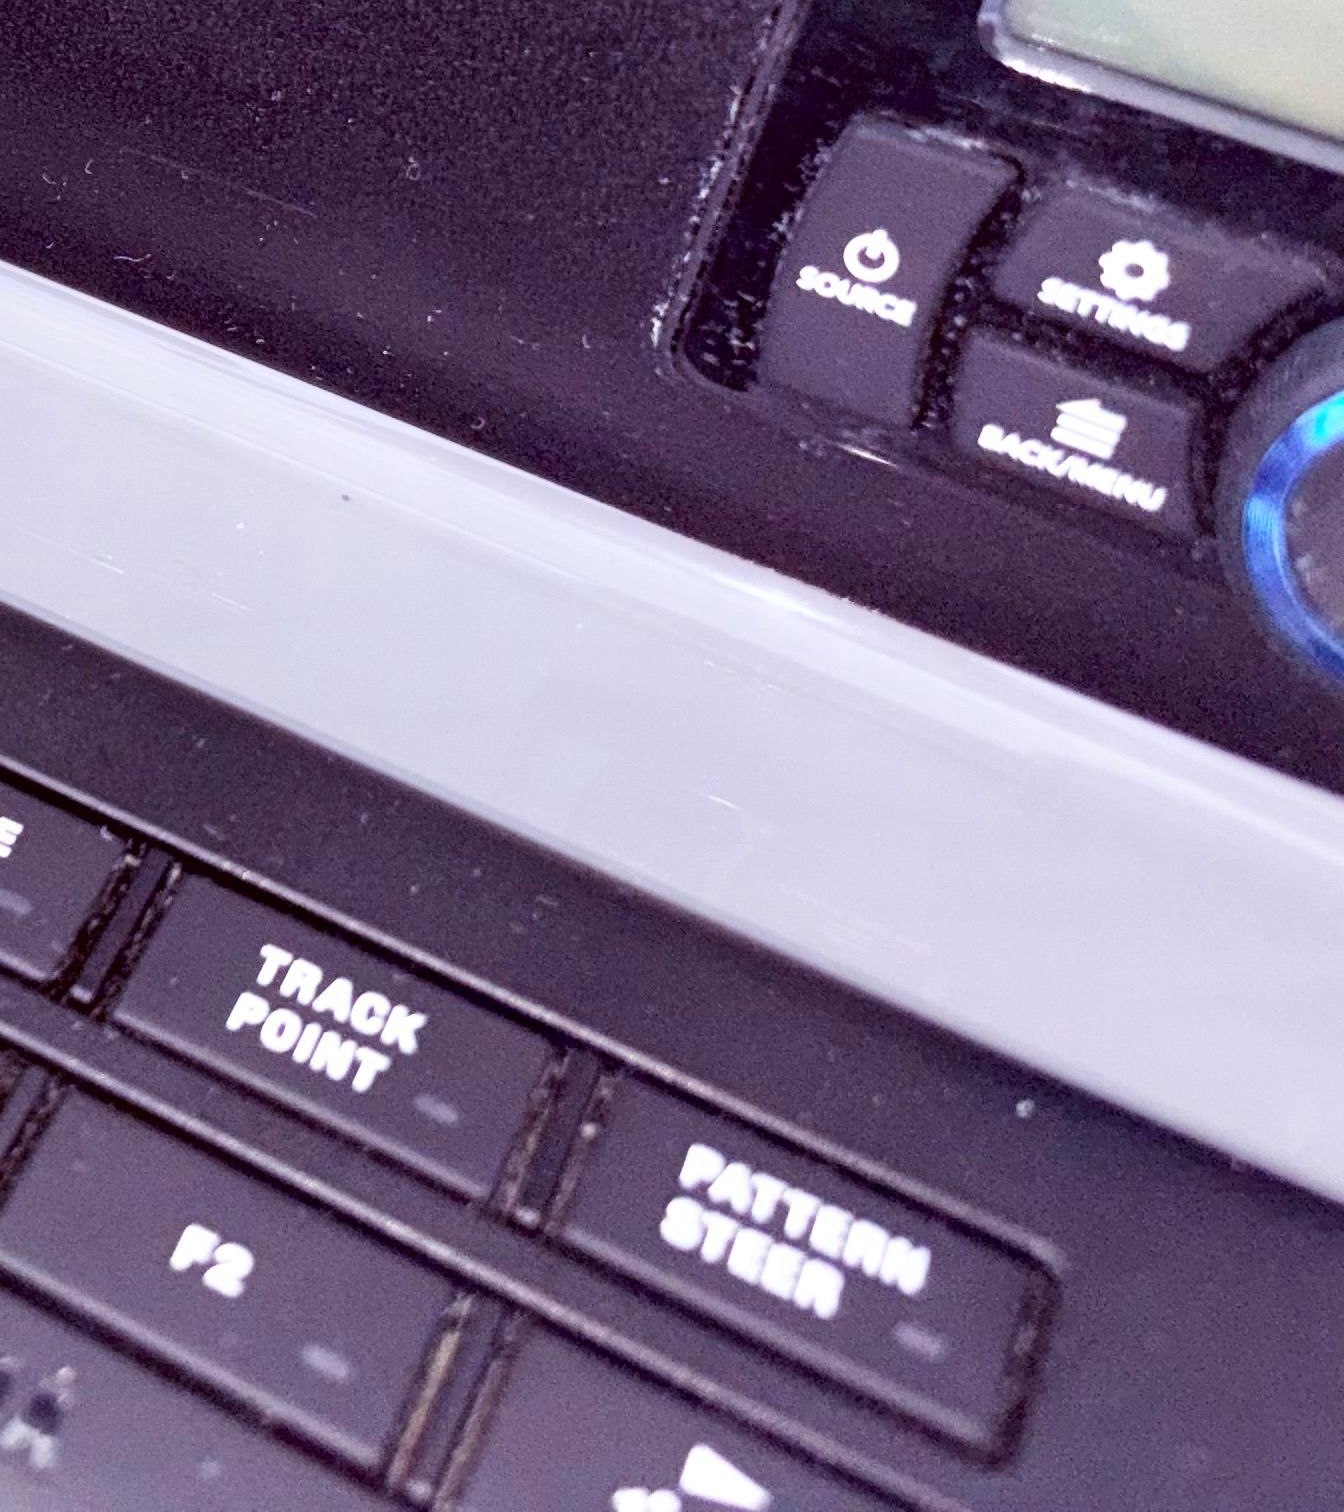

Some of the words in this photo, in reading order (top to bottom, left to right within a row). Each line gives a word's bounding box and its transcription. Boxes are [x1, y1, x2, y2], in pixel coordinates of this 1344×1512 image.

[796, 265, 917, 328] SOURCE
[1038, 277, 1191, 352] SETTINGS
[977, 424, 1167, 513] BACK/MENU
[227, 993, 391, 1093] POINT
[259, 944, 428, 1055] TRACK
[170, 1224, 257, 1299] F2
[659, 1196, 845, 1321] STEER
[679, 1143, 932, 1297] PATTERN
